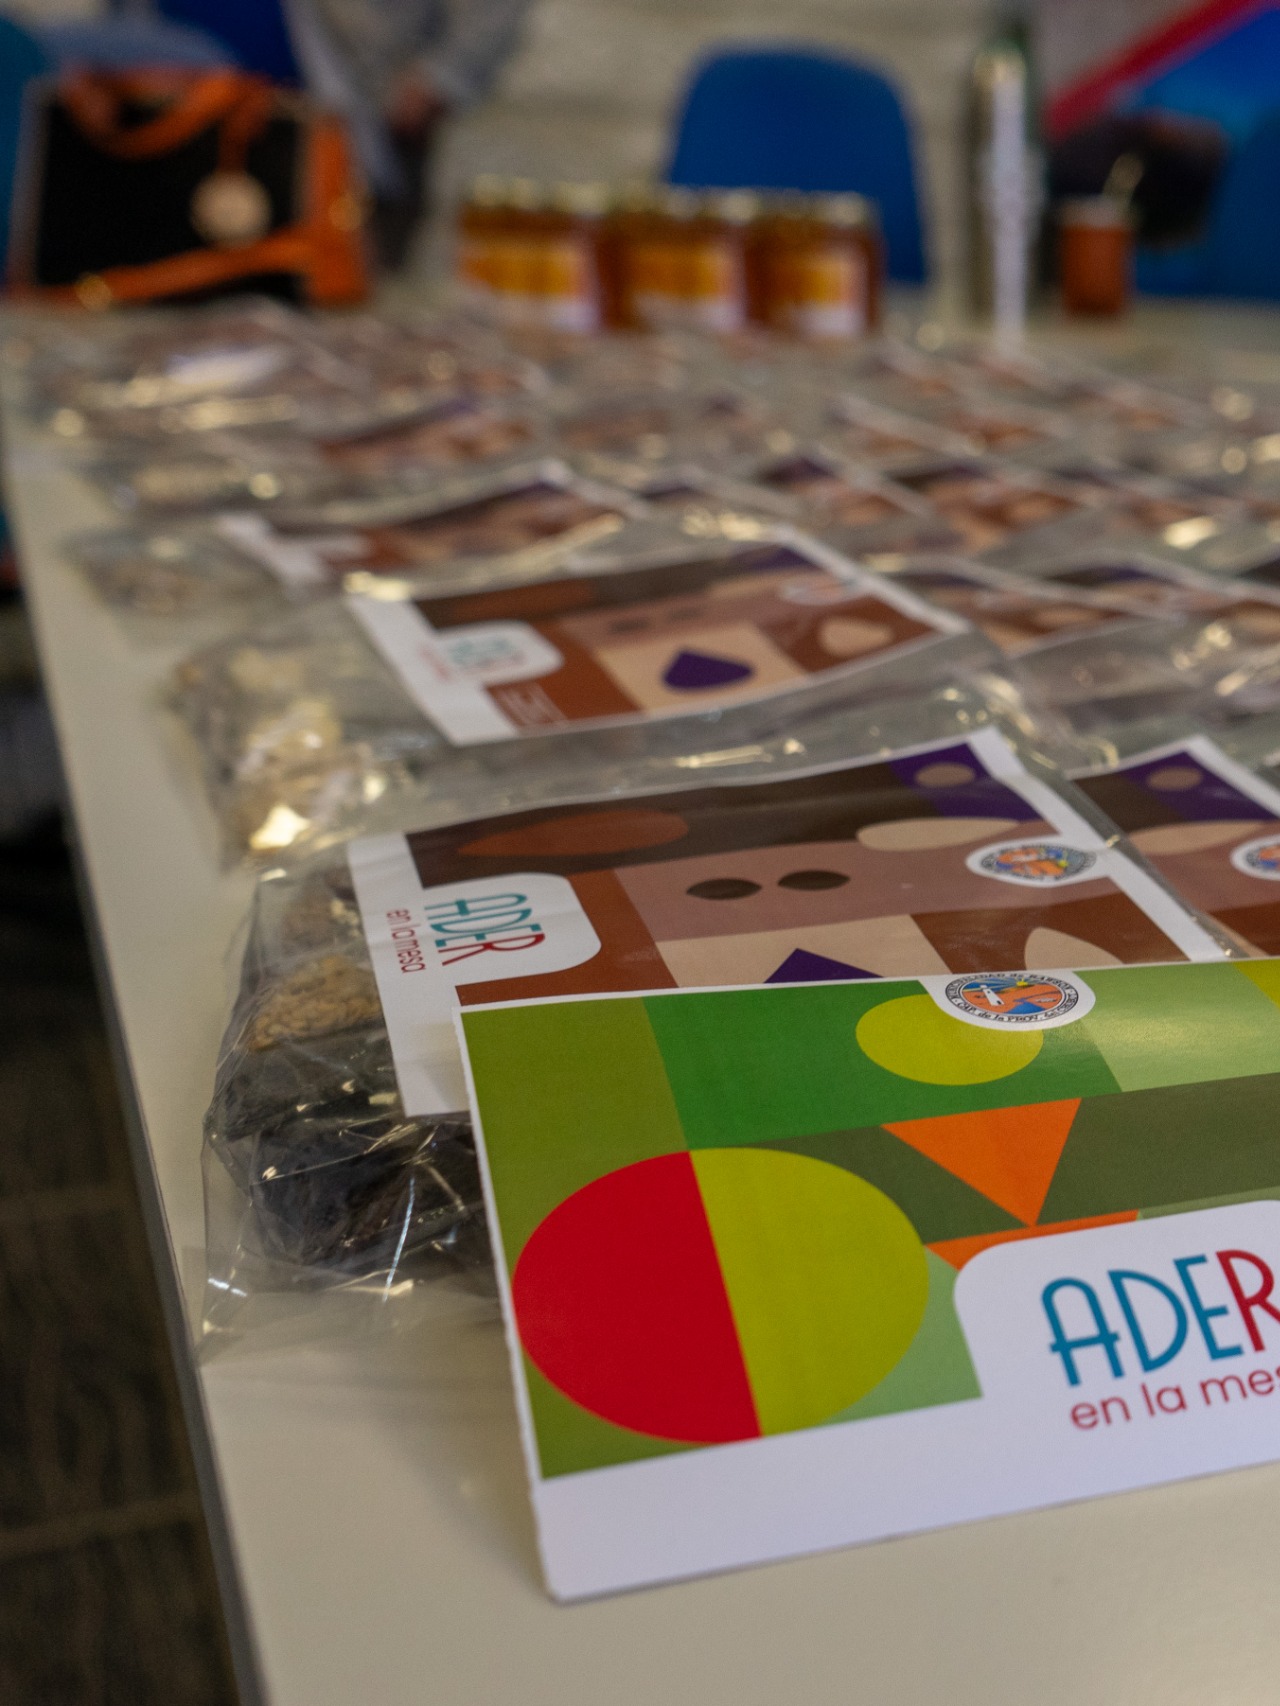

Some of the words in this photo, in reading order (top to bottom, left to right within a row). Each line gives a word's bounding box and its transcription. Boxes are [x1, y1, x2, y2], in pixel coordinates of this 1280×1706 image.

[424, 893, 545, 966] ADER
[395, 938, 427, 973] mesa
[1069, 1395, 1132, 1430] en
[1140, 1383, 1189, 1417] la
